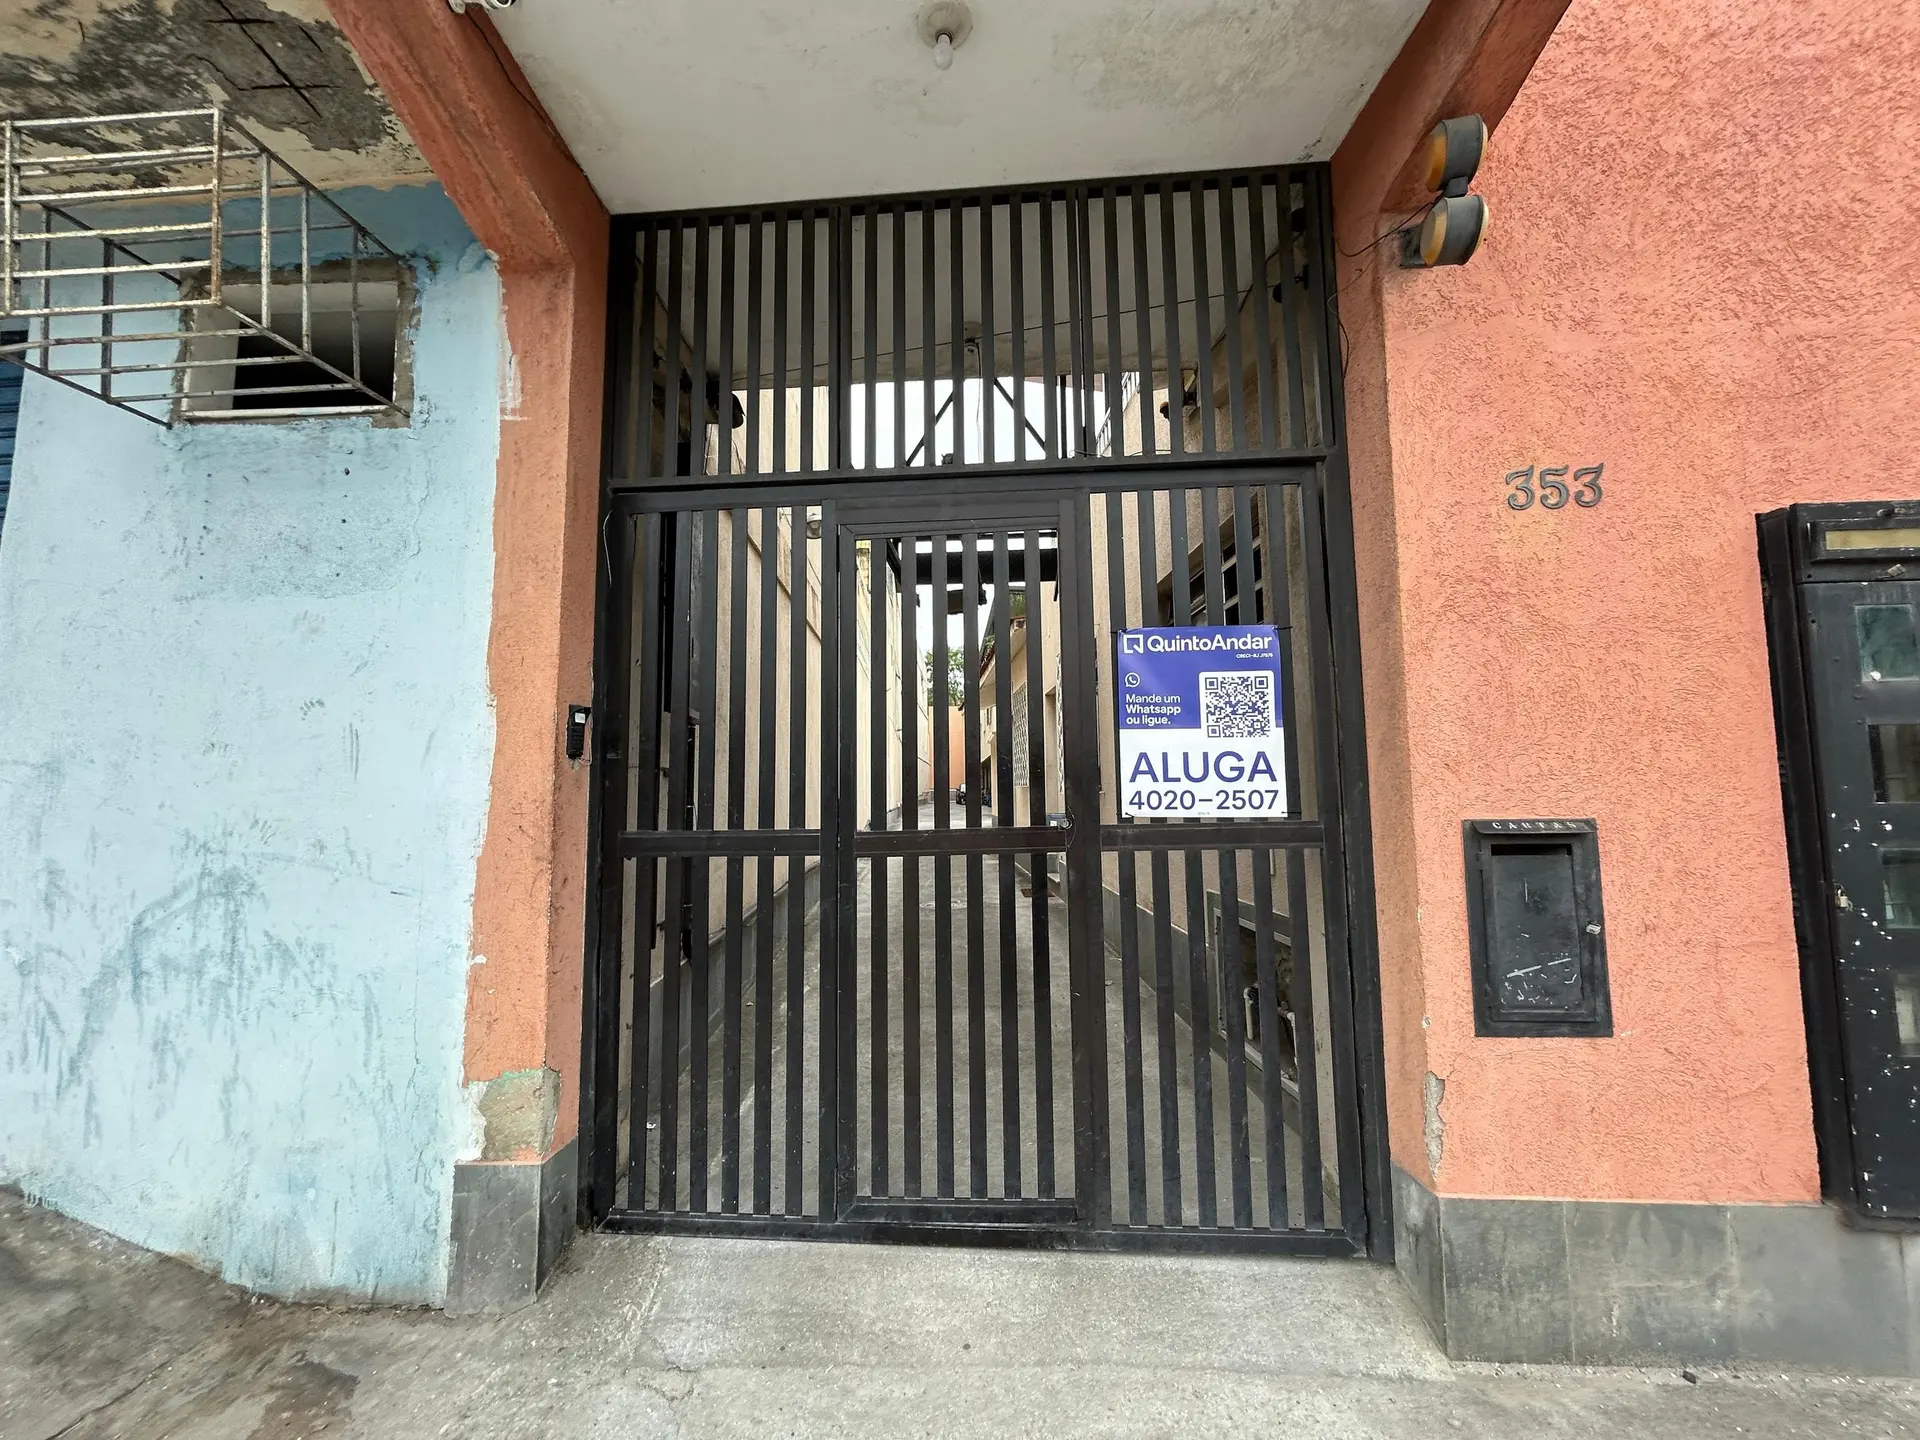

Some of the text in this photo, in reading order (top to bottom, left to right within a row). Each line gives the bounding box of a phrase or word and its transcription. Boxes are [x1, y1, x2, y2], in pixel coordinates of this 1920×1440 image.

[1505, 462, 1604, 510] 353
[1147, 633, 1272, 653] QuintoAndar
[1125, 693, 1181, 703] Mande um
[1125, 704, 1181, 716] Whatsapp
[1126, 714, 1171, 727] ou ligue.
[1129, 751, 1277, 783] ALUGA
[1129, 789, 1279, 810] 4020-2507
